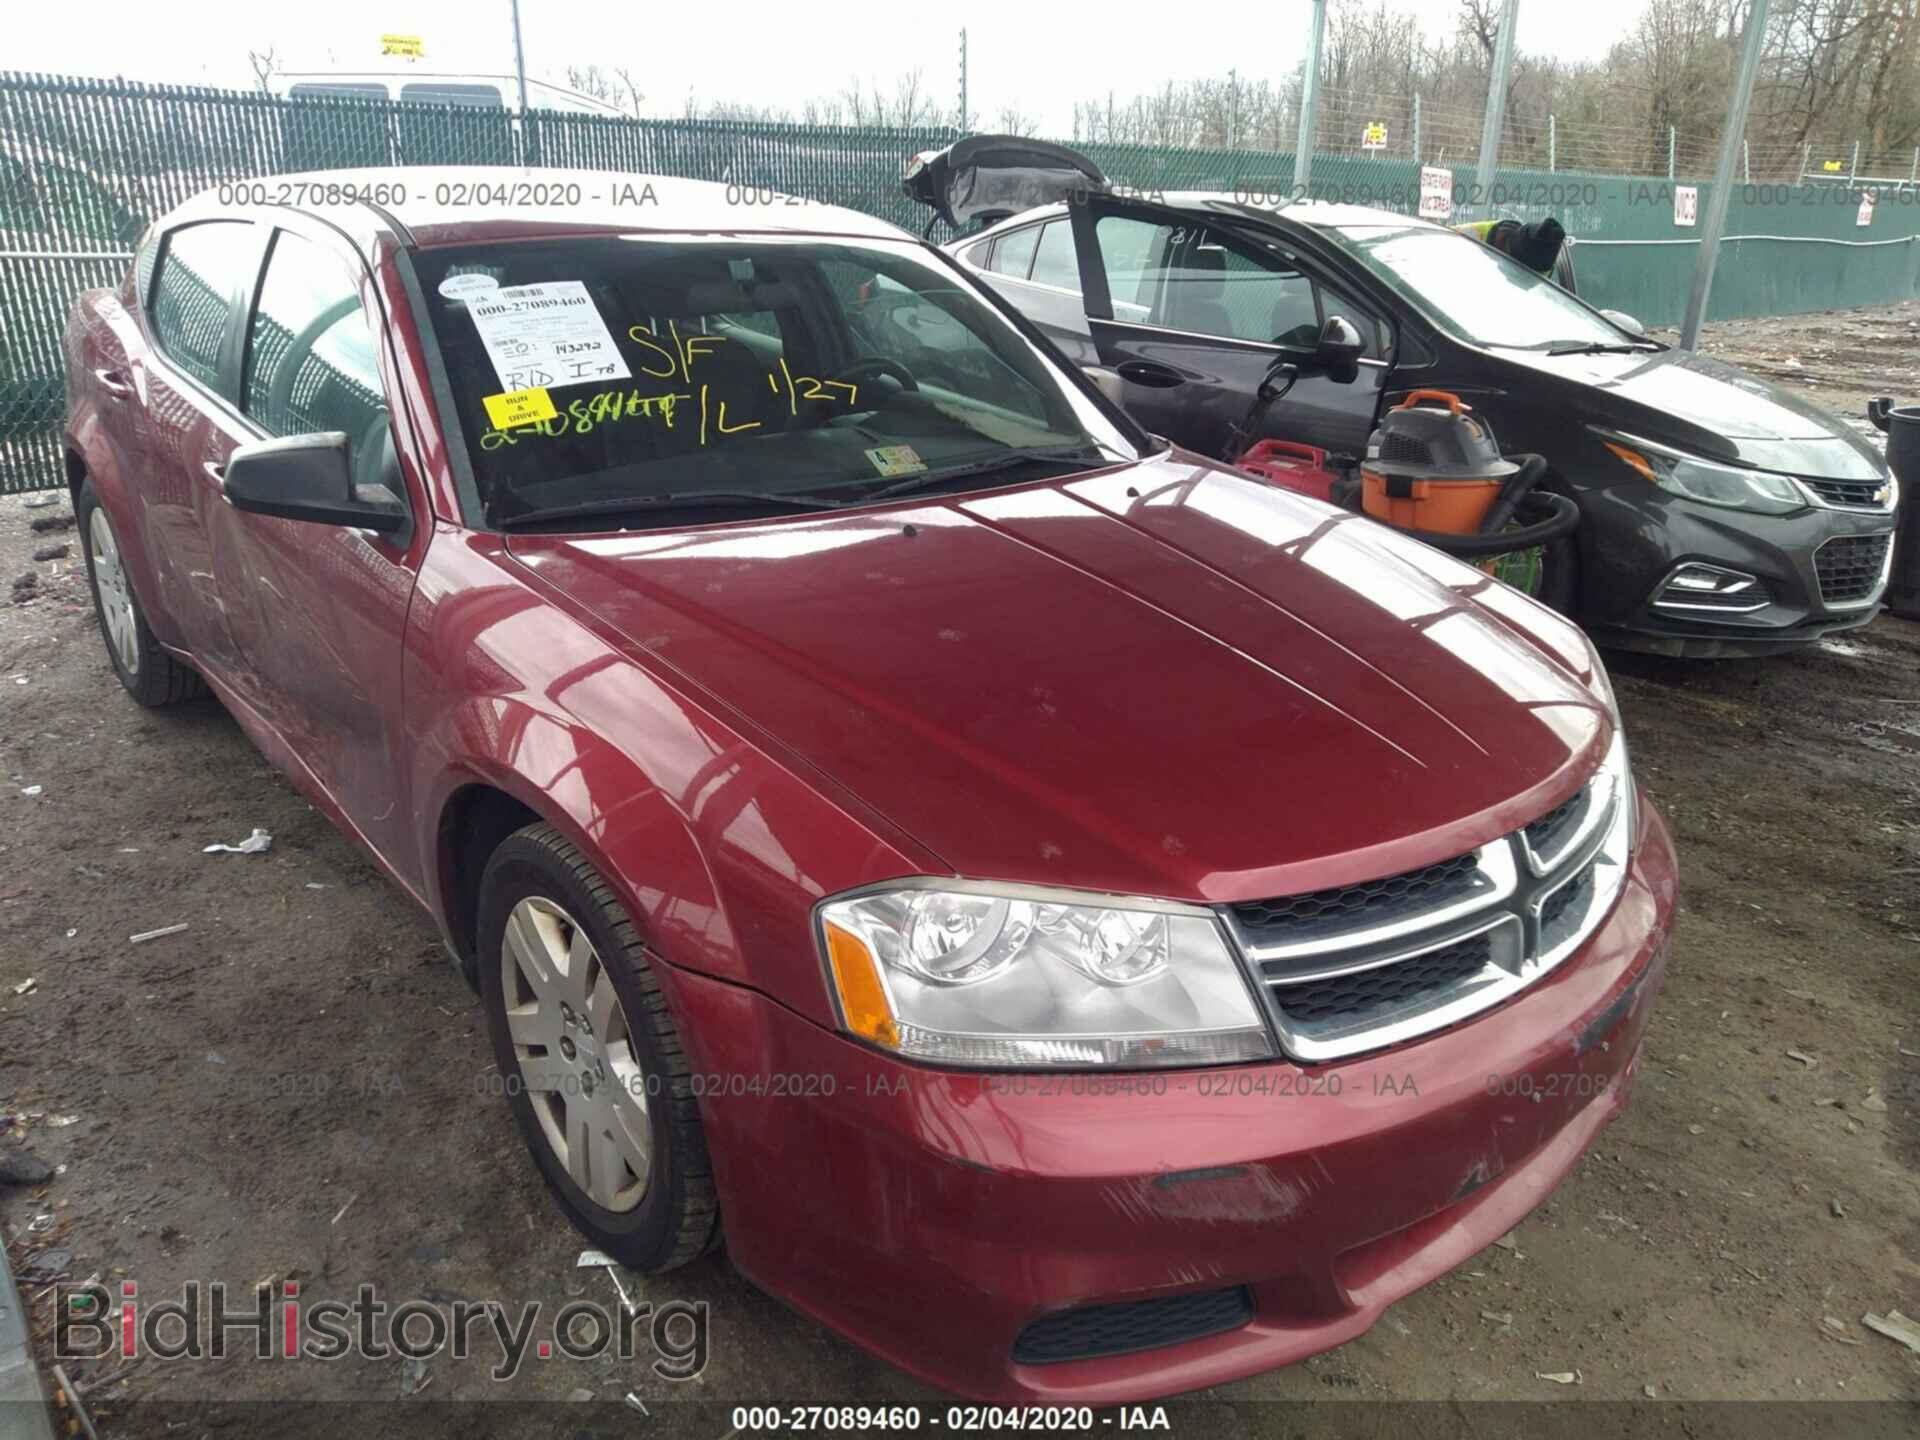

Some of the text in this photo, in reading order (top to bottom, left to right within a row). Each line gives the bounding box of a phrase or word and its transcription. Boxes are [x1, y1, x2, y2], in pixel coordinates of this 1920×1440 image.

[476, 296, 587, 317] 000-27089460
[506, 395, 529, 405] RUN
[508, 410, 540, 423] DRIVE
